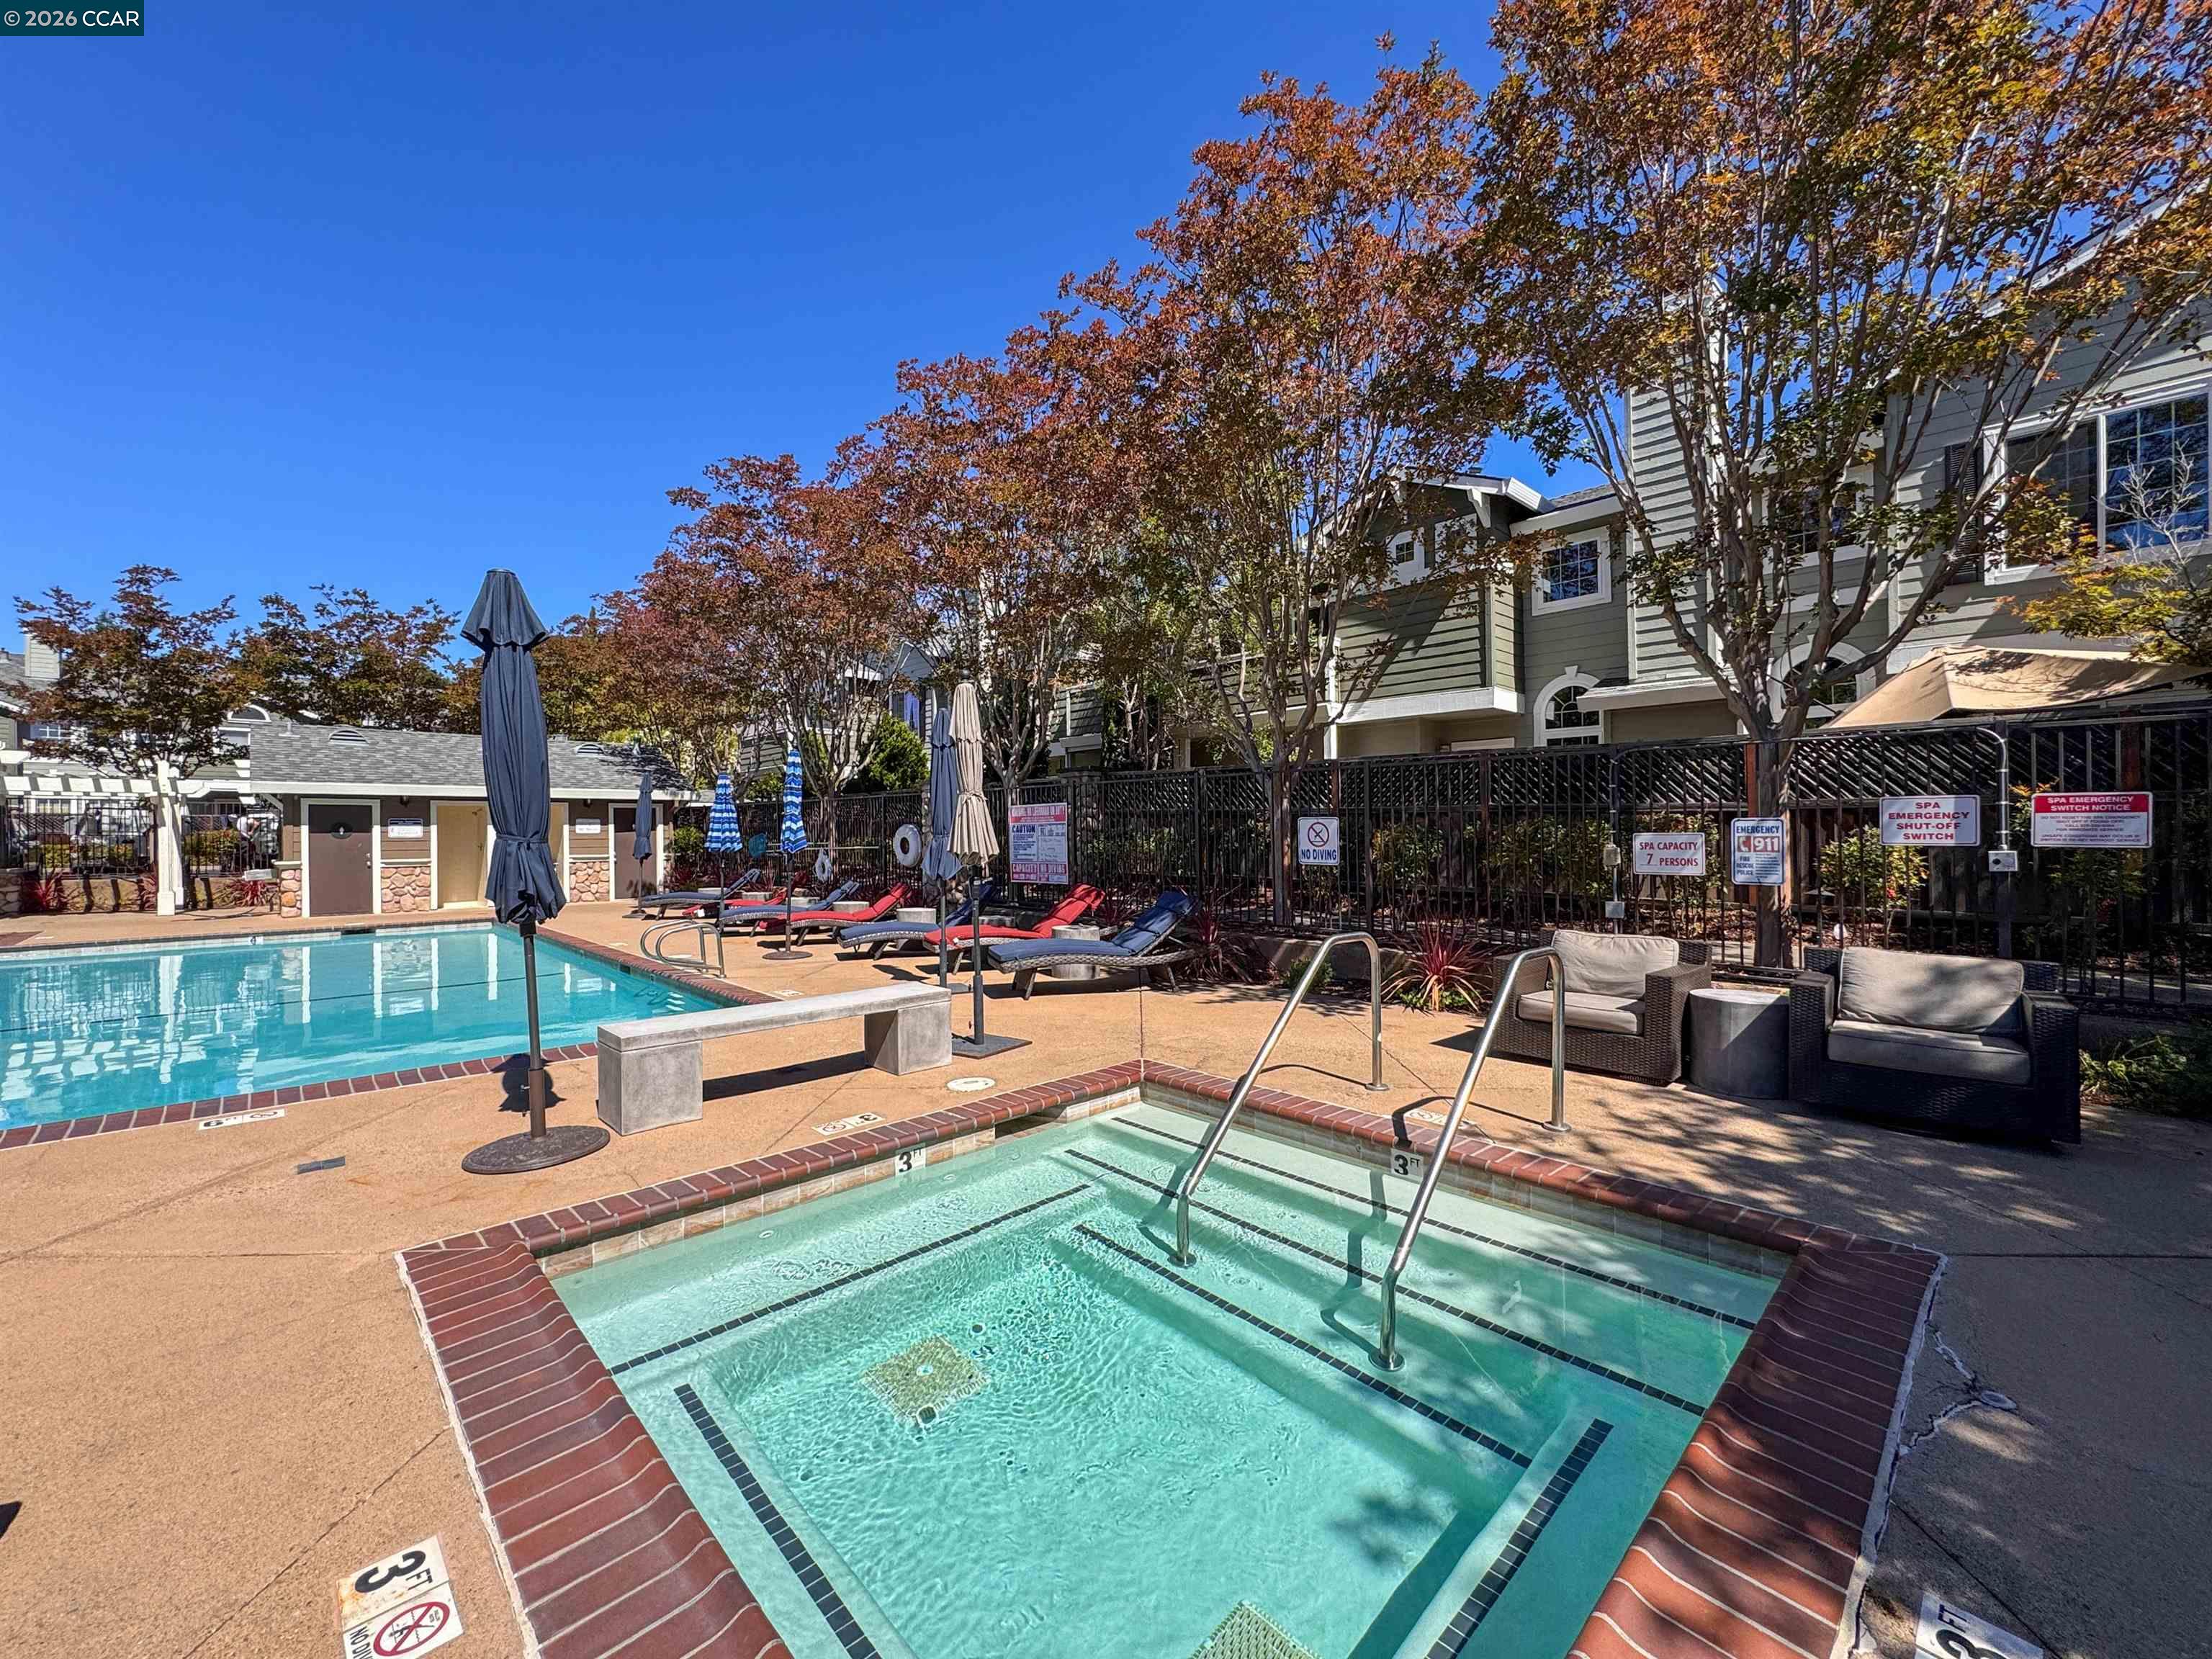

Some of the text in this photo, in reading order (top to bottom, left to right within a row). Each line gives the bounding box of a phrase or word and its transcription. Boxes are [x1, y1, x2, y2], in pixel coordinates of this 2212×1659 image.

[1012, 824, 1036, 833] CAUTION
[1736, 825, 1780, 834] EMERGENCY
[1639, 842, 1698, 850] SPA CAPACITY
[1753, 837, 1779, 851] 911
[1301, 849, 1337, 860] NO DIVING
[1647, 853, 1699, 866] 7 PERSONS
[1012, 863, 1037, 873] CAPACITY
[899, 1148, 922, 1173] 3 FT
[1394, 1154, 1420, 1176] 3 FT
[354, 1550, 433, 1593] 3 FT
[1938, 1604, 1969, 1634] FT
[349, 1625, 369, 1645] NO
